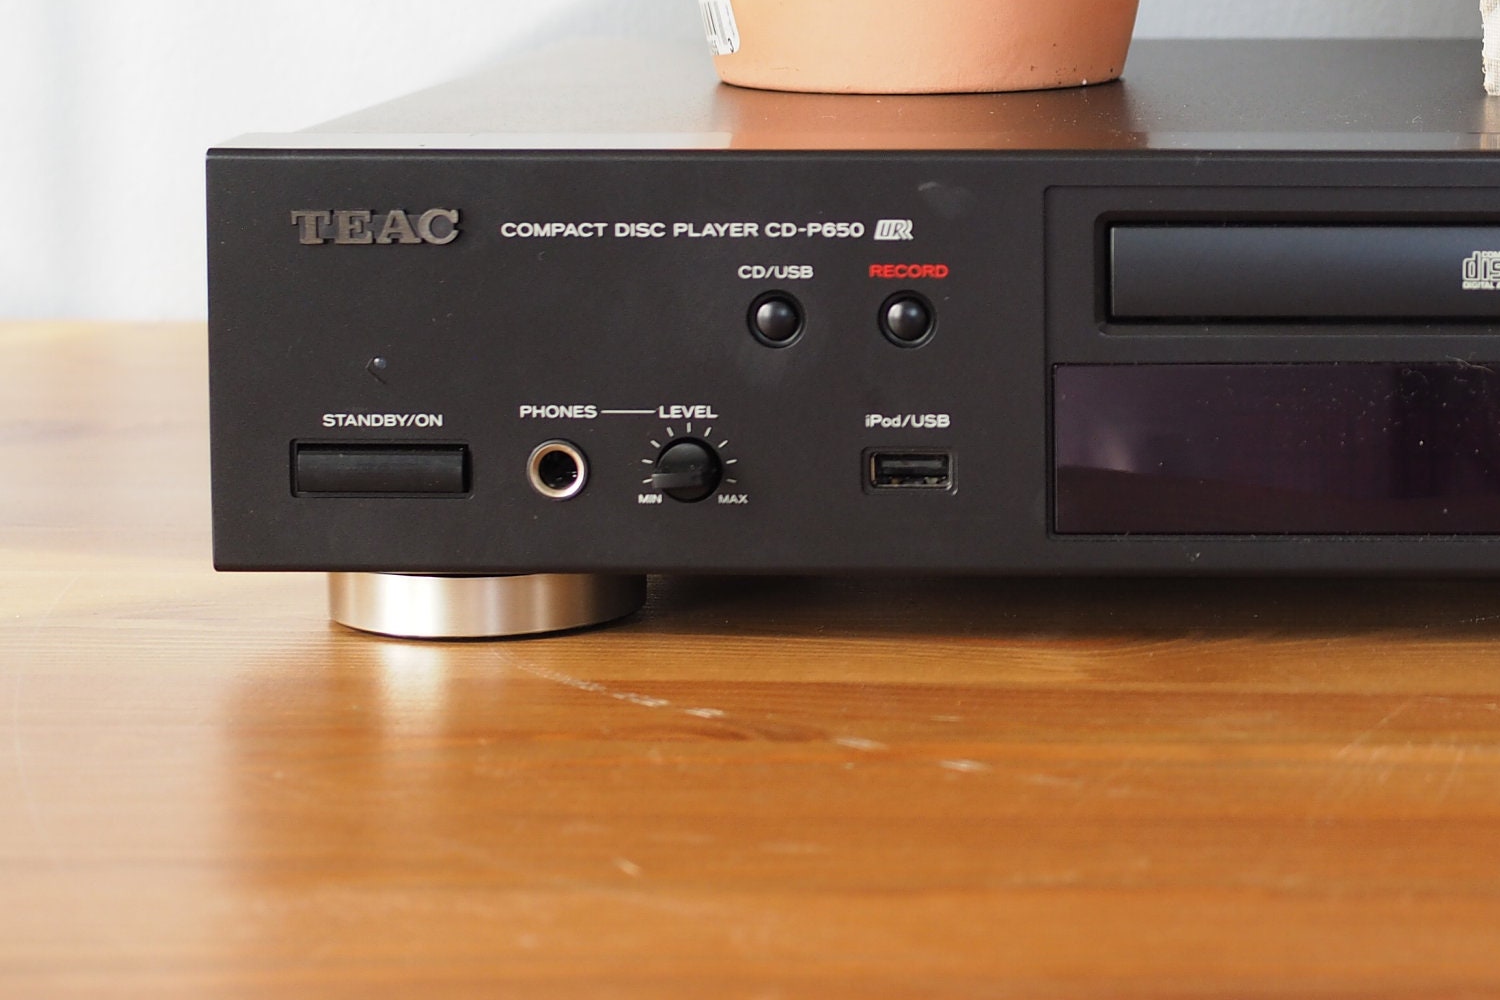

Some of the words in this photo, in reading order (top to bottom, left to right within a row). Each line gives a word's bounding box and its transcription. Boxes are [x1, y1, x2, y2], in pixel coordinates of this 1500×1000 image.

[290, 208, 460, 245] TEAC
[500, 222, 609, 238] COMPACT
[613, 222, 667, 238] DISC
[673, 222, 759, 238] PLAYER
[764, 222, 865, 238] CD-P650
[737, 264, 814, 280] CD/USB
[868, 263, 950, 279] RECORD
[519, 405, 598, 420] PHONES
[658, 405, 719, 420] LEVEL
[321, 413, 444, 428] STANDBY/ON
[864, 413, 951, 428] iPod/USB
[637, 493, 663, 505] MIN
[717, 493, 749, 505] MAX
